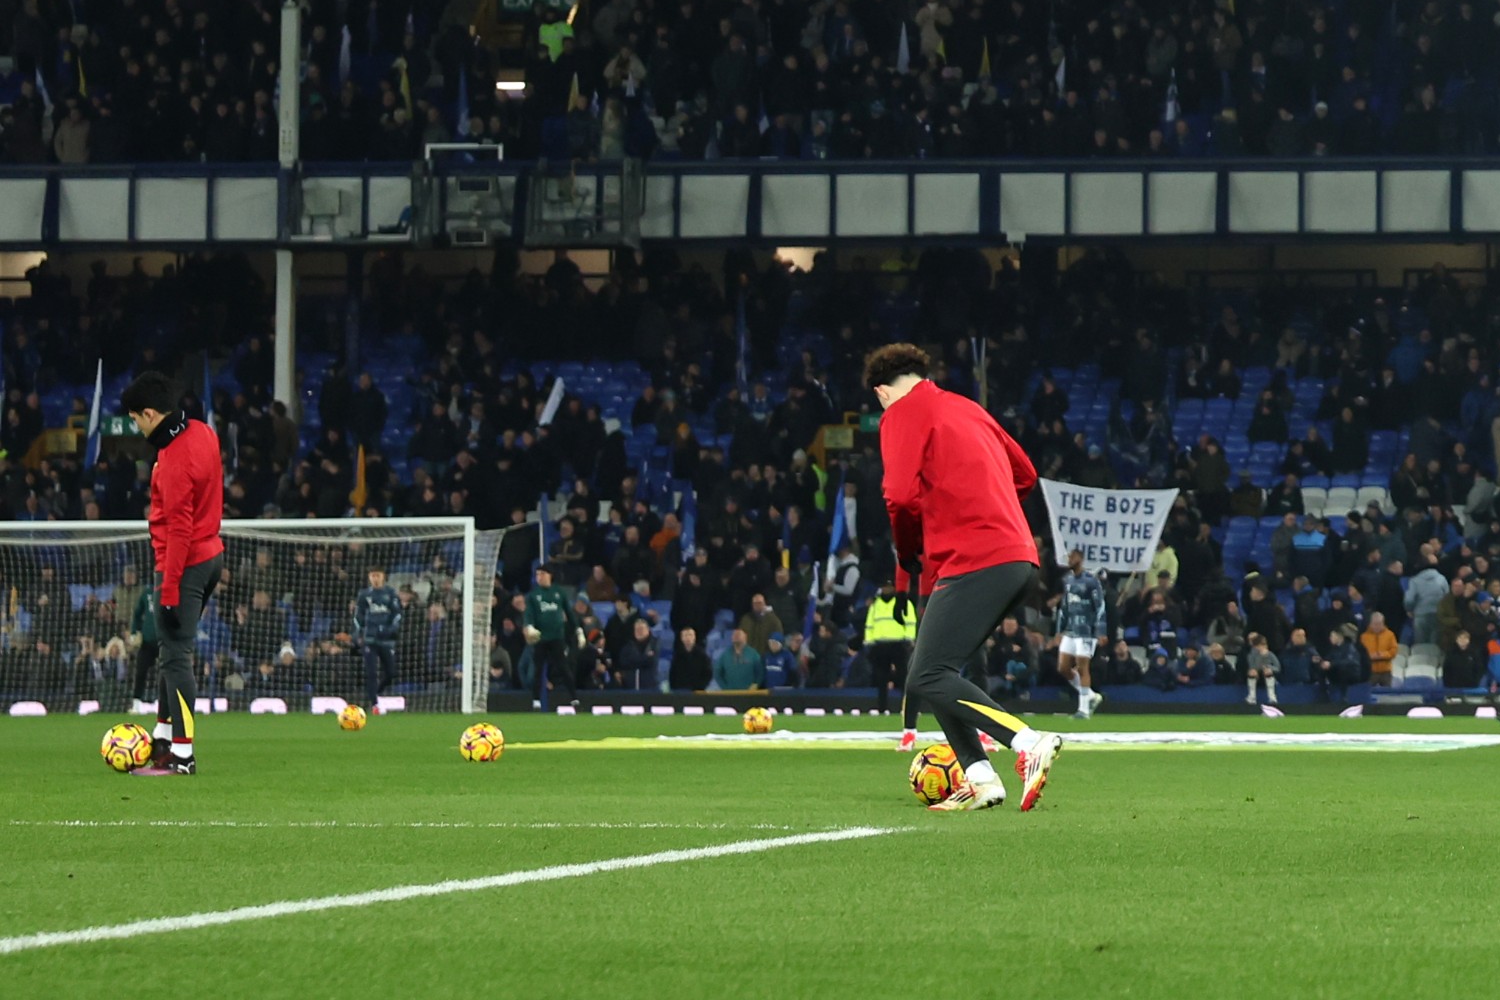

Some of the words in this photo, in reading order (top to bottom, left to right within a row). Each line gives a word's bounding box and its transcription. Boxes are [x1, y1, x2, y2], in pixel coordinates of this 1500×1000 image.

[1059, 491, 1095, 512] THE
[1106, 496, 1156, 515] BOYS
[1059, 515, 1108, 538] FROM
[1119, 522, 1155, 540] THE
